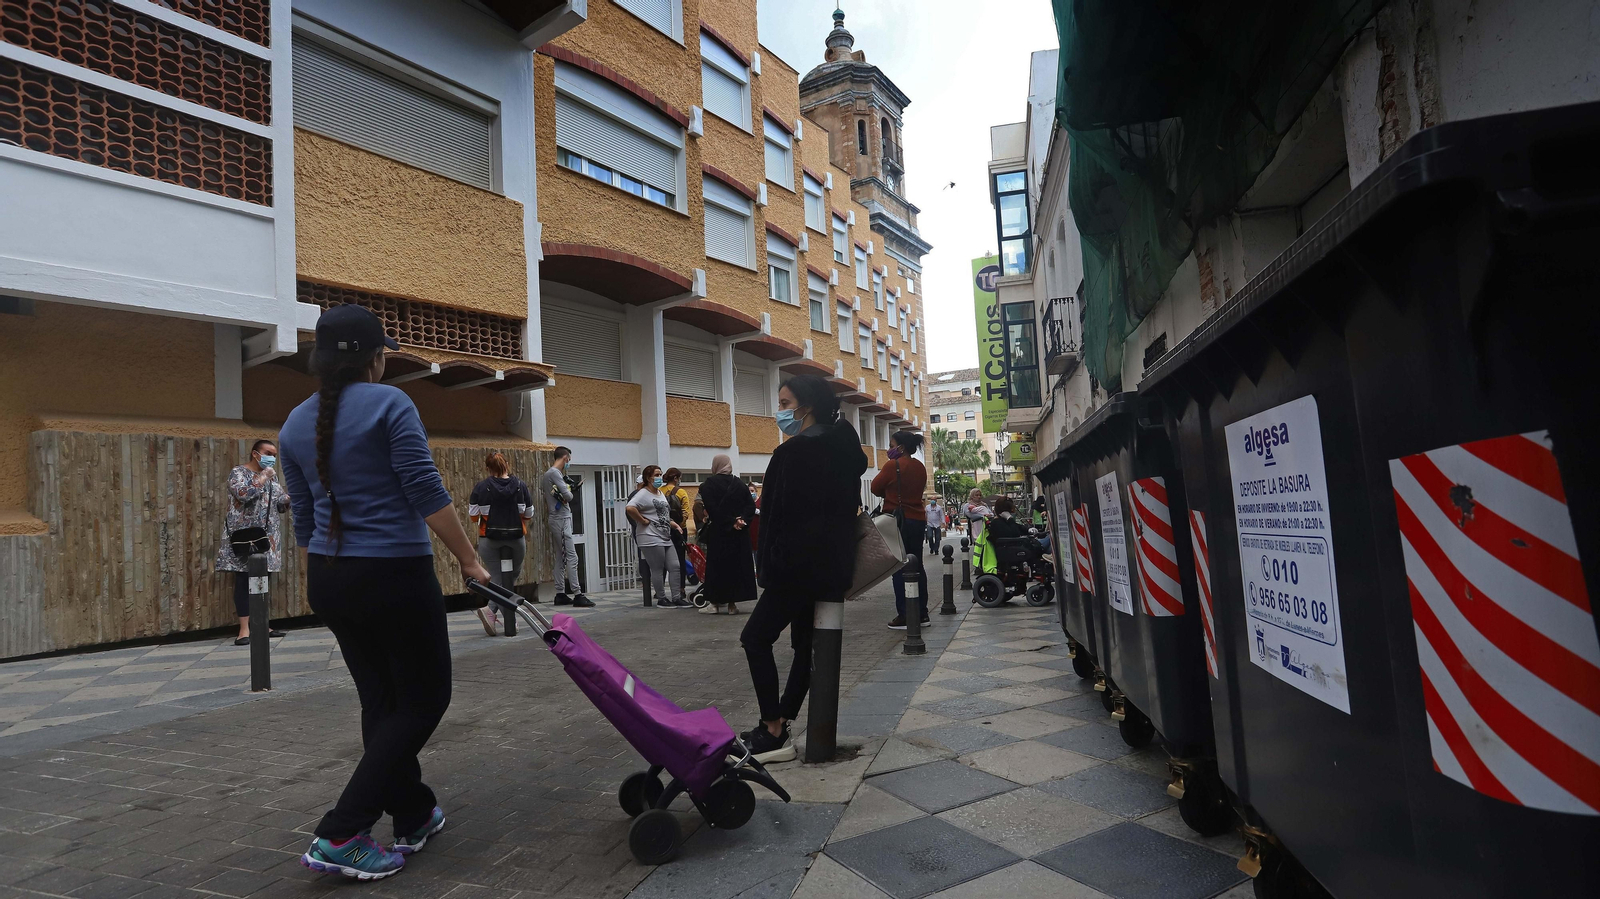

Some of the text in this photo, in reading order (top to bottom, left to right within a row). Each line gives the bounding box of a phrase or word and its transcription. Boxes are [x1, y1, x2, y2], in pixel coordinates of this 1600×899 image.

[1244, 422, 1289, 456] algesa
[1240, 474, 1311, 497] DEPOSITE LA BASURA
[1281, 502, 1286, 513] de
[1299, 503, 1302, 512] a
[1303, 500, 1316, 512] 22:30
[1282, 517, 1287, 528] de
[1301, 519, 1304, 529] a
[1304, 517, 1318, 529] 22:30
[1272, 558, 1298, 585] 010
[1259, 587, 1275, 610] 956
[1278, 592, 1291, 614] 65
[1293, 595, 1308, 619] 03
[1311, 600, 1328, 625] 08
[343, 845, 369, 864] N
